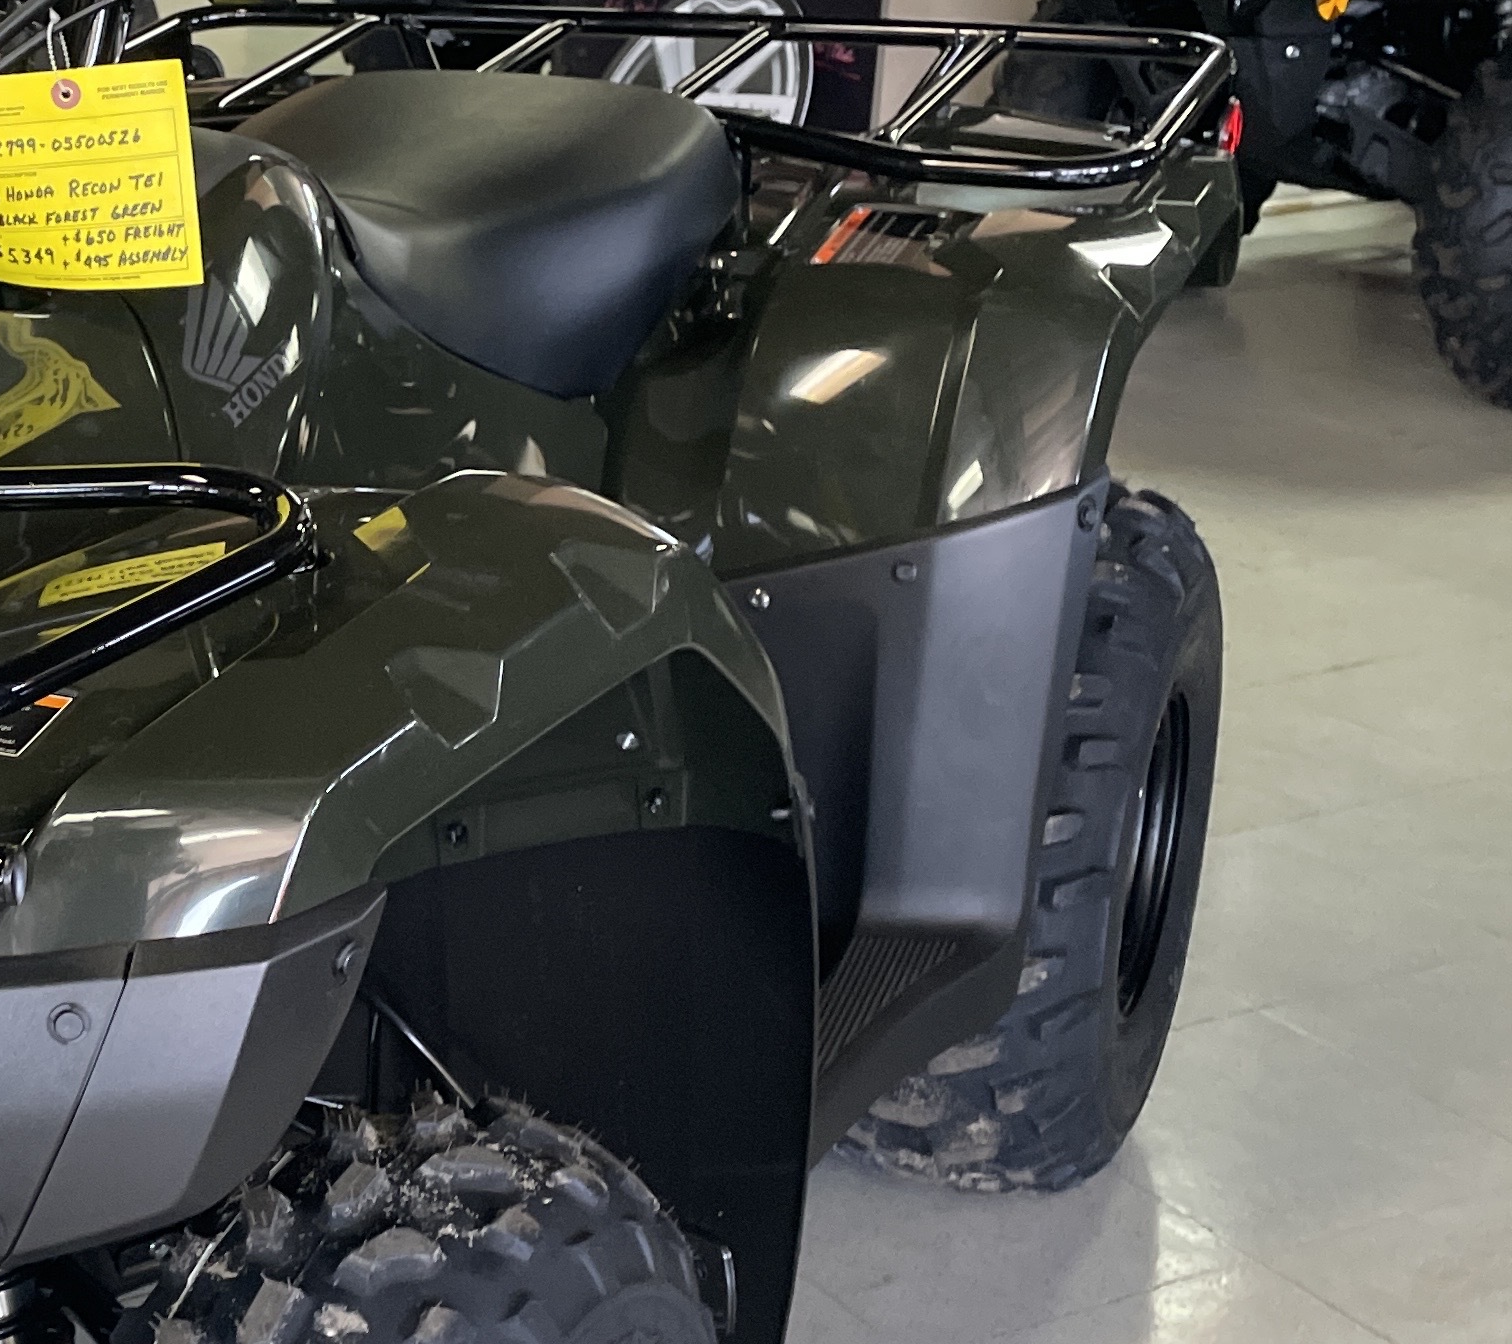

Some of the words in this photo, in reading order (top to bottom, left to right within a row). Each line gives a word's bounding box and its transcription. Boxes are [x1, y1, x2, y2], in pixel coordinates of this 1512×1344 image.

[68, 177, 121, 198] RECON
[45, 207, 99, 225] FOREST
[111, 199, 163, 221] GREEN
[124, 222, 185, 243] FREIGHT
